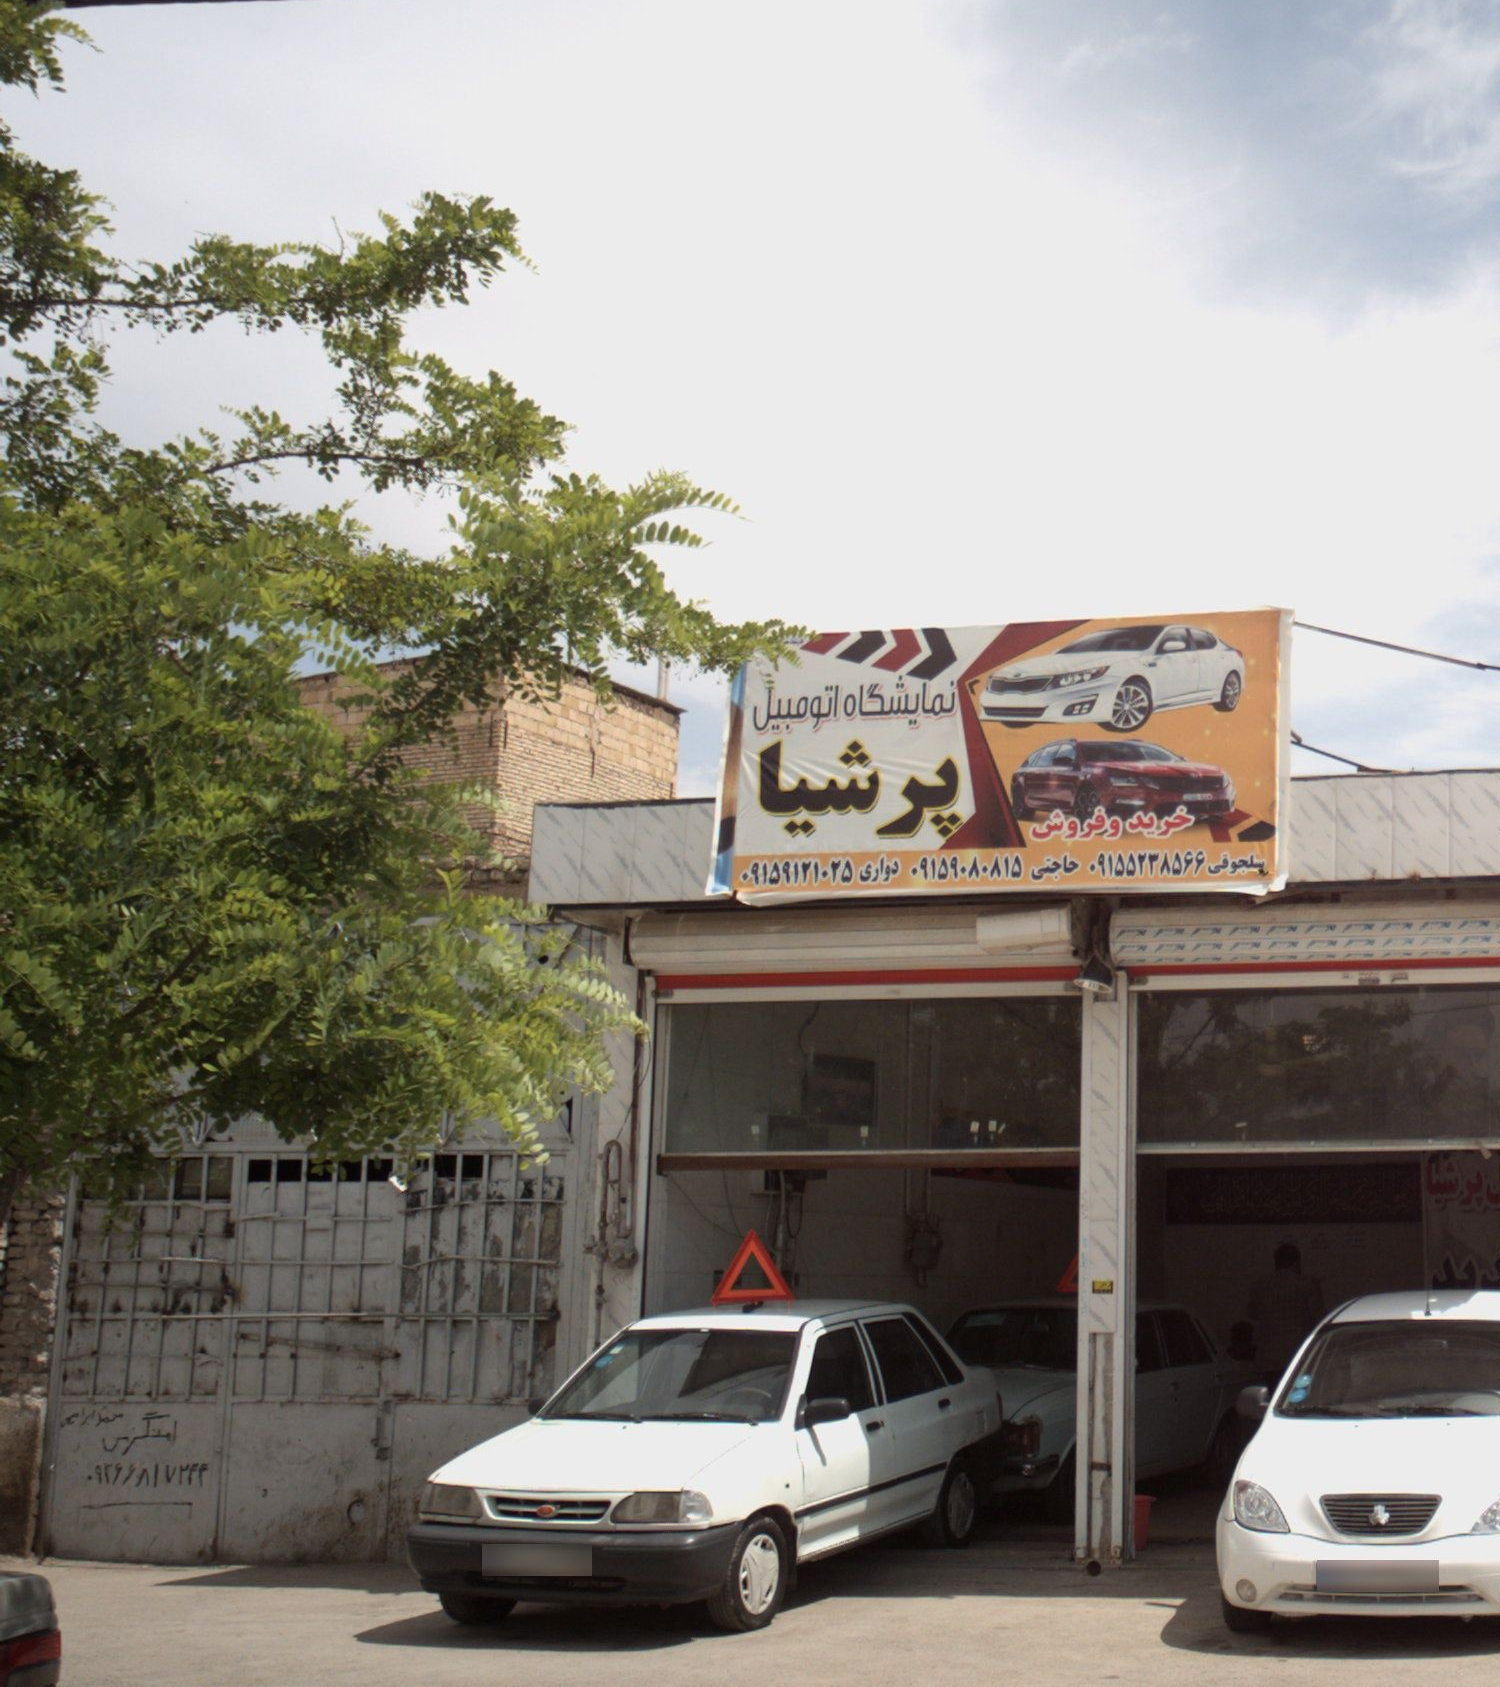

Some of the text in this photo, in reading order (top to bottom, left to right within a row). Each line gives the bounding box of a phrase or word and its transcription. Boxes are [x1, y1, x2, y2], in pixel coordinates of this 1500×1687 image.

[752, 675, 957, 732] نمایشگاه اتومبیل
[758, 739, 963, 839] پرشیا
[1127, 806, 1195, 837] خرید
[910, 854, 1023, 881] ۰۹۱۵۹۰۸۰۸۱۵
[1030, 854, 1080, 881] حاجتی
[1088, 850, 1206, 878] ۰۹۱۵۵۲۳۸۵۶۶
[1207, 852, 1266, 876] سلجوقی
